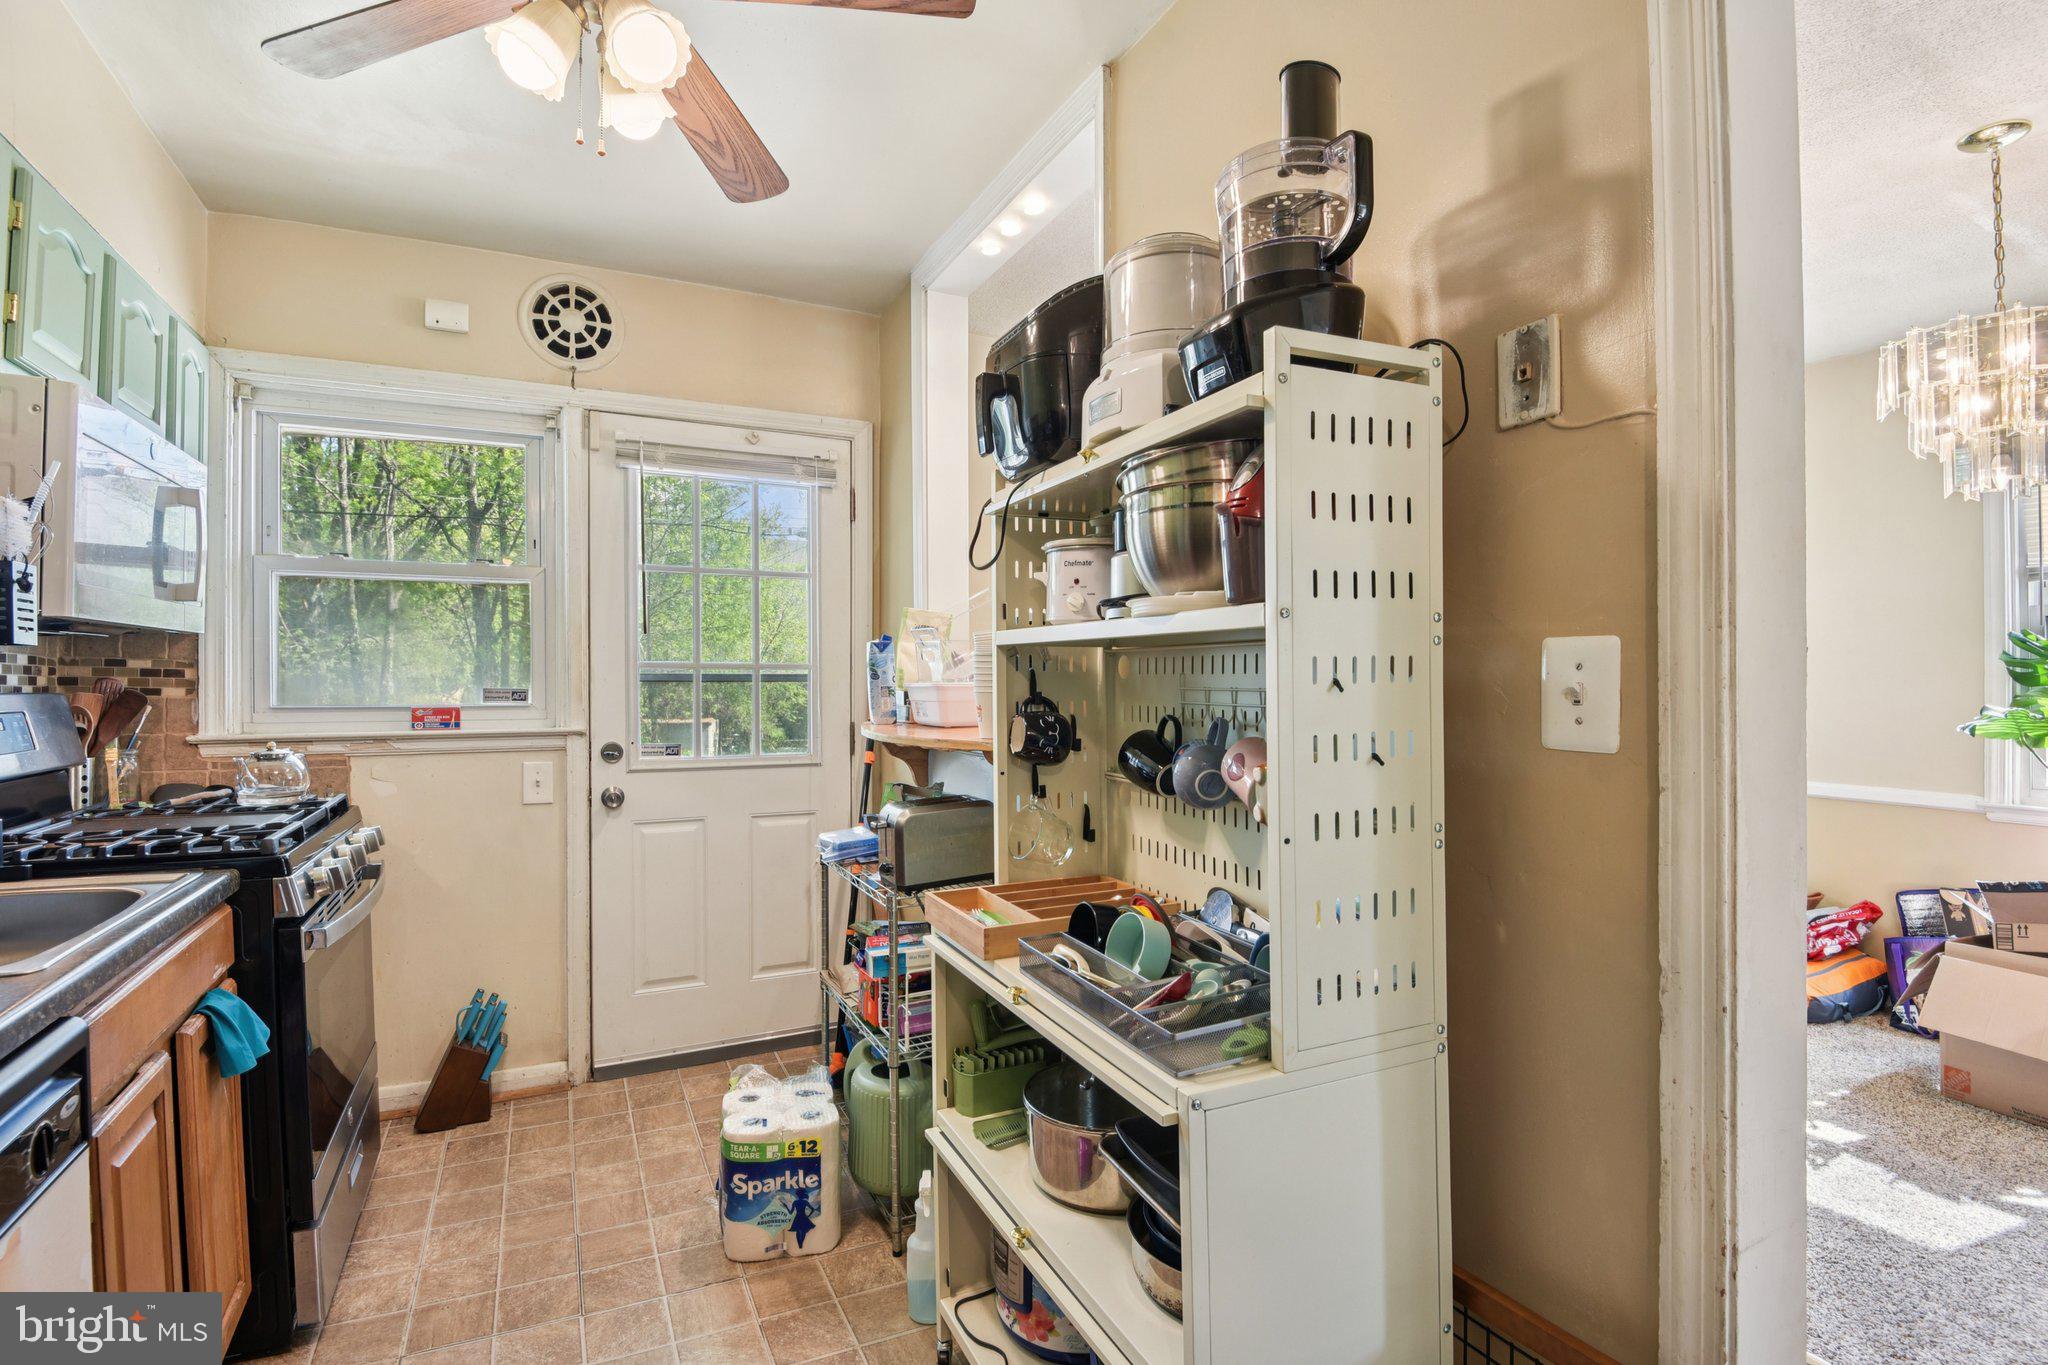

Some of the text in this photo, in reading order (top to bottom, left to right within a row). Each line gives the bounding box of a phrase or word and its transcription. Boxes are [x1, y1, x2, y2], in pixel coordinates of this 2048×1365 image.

[513, 692, 526, 700] ADT
[788, 1140, 818, 1153] 6 12
[730, 1151, 760, 1159] SQUARE
[732, 1168, 819, 1200] Sparkle
